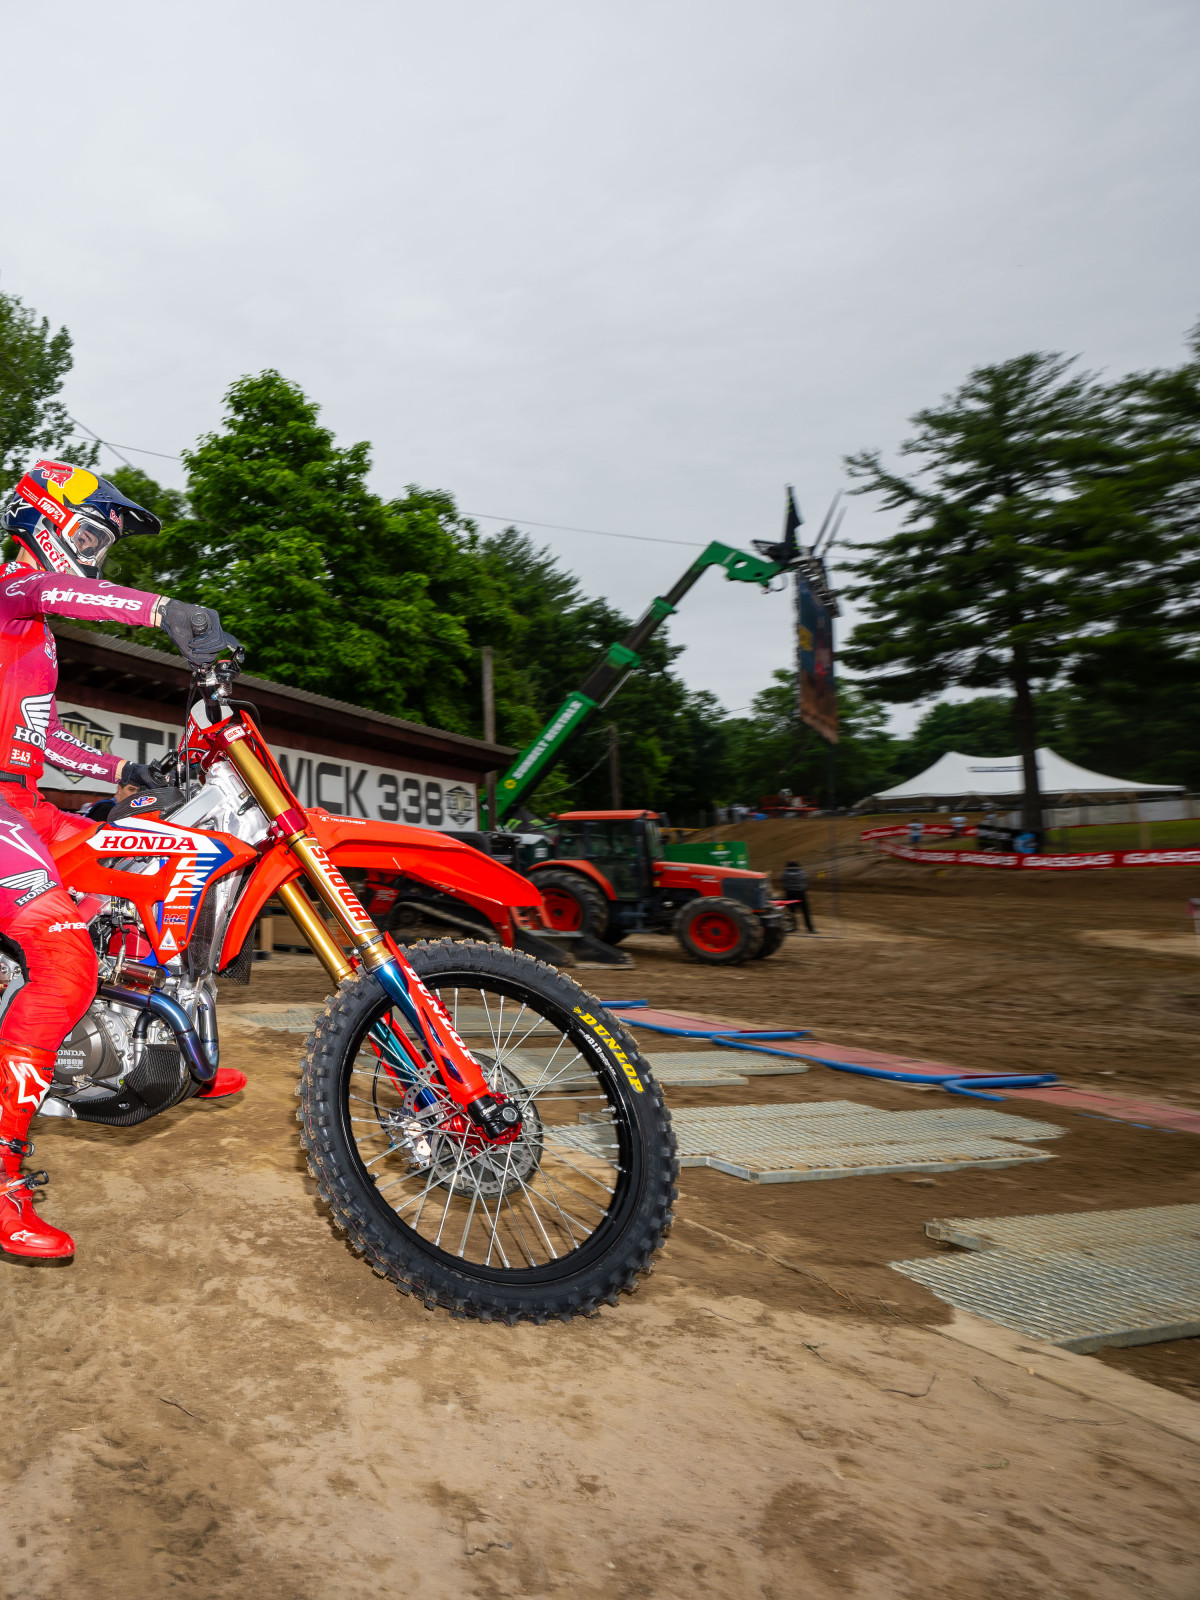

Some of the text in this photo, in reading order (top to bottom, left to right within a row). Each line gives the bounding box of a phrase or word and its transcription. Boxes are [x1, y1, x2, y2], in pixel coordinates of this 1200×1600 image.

[40, 501, 62, 520] 100%
[41, 588, 143, 611] alpinestars
[13, 726, 47, 750] HON
[378, 774, 442, 826] 338
[100, 835, 198, 851] HONDA
[15, 880, 58, 906] HONDA
[308, 845, 372, 923] SHOWA
[48, 920, 87, 933] alpines
[404, 965, 478, 1065] DUNLOP
[57, 1049, 87, 1057] ONDA
[579, 1012, 644, 1092] DUNLOP
